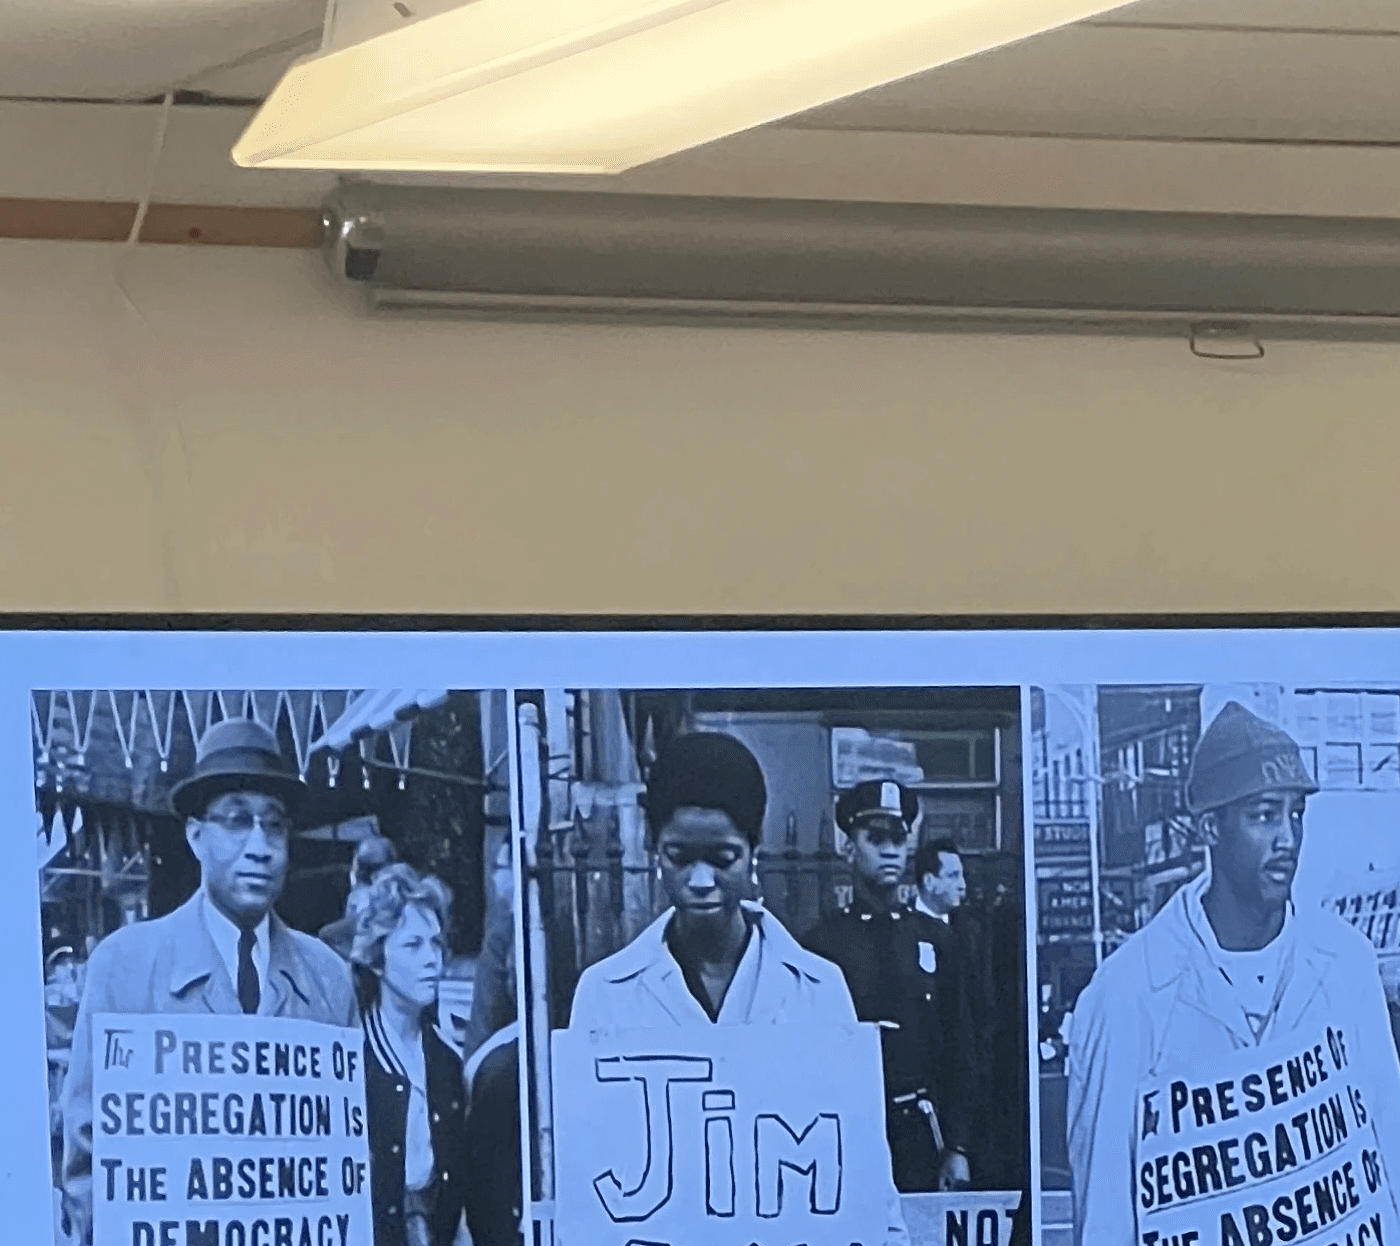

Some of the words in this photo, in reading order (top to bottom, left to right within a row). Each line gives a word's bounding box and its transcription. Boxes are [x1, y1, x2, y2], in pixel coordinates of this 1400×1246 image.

[154, 1029, 322, 1078] PRESENCE
[332, 1042, 358, 1083] OF
[1170, 1052, 1329, 1135] PRESENCE
[1327, 1026, 1349, 1069] OF
[101, 1093, 330, 1137] SEGREGATION
[1140, 1093, 1348, 1209] SEGREGATION
[101, 1158, 167, 1201] THE
[187, 1156, 328, 1200] ABSENCE
[341, 1156, 365, 1197] OF
